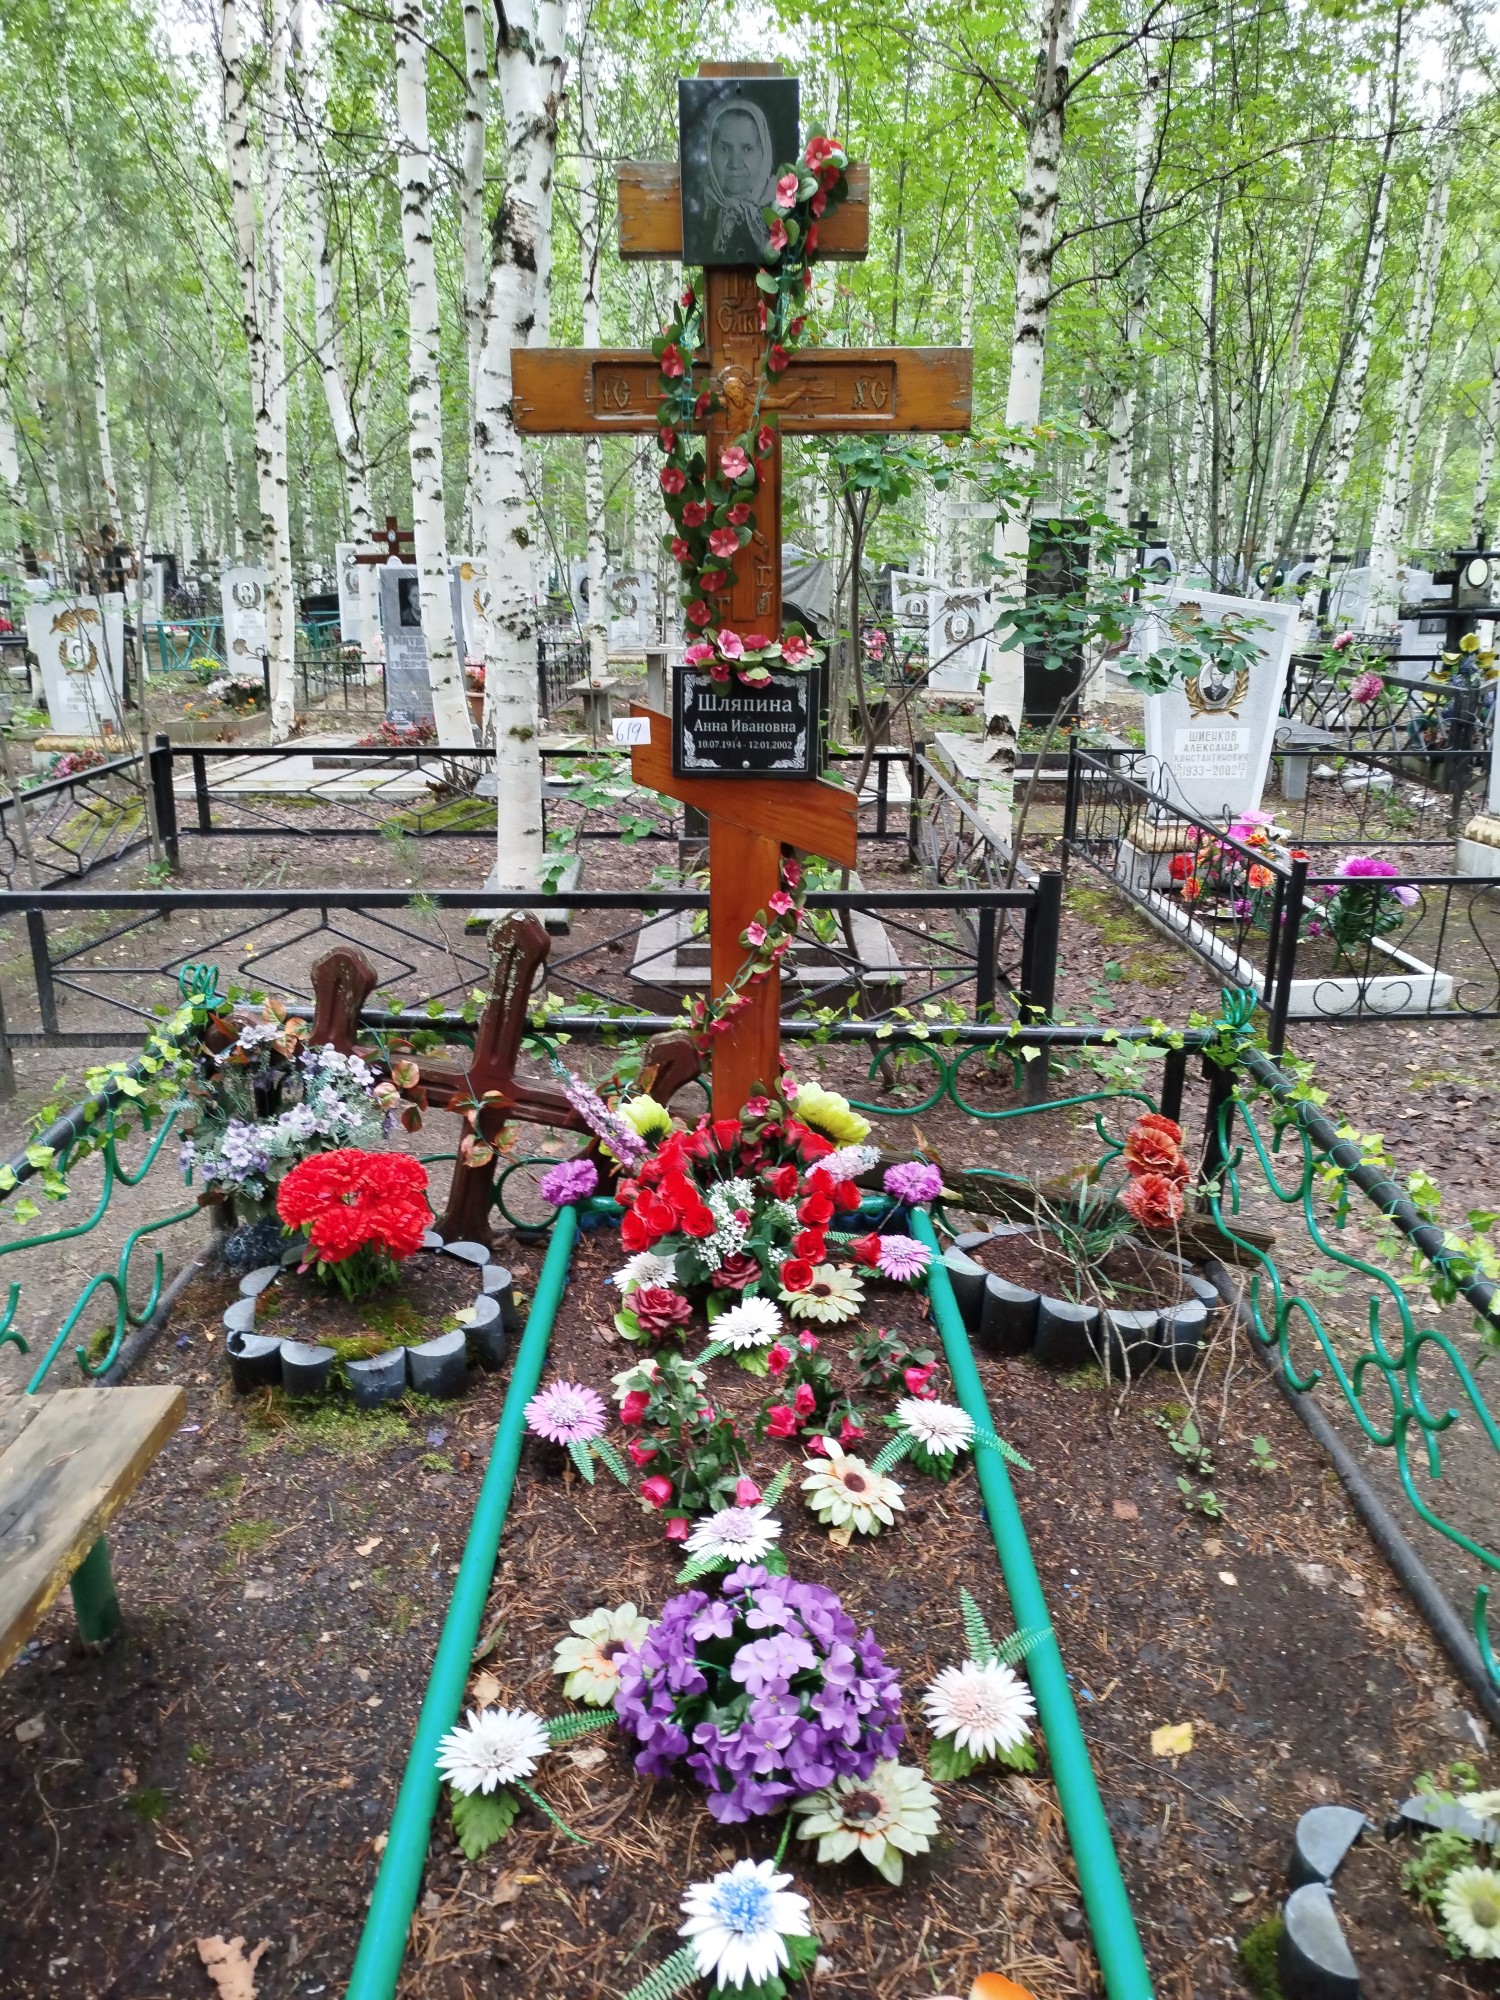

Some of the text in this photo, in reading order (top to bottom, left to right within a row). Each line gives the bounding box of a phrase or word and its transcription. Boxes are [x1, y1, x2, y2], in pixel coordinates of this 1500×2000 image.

[697, 693, 793, 713] Шляпина
[693, 718, 796, 733] Анна Ивановна
[616, 721, 642, 743] 619
[697, 740, 742, 749] 10.07.1914
[749, 740, 793, 750] 12.01.2002
[1183, 743, 1240, 753] АЛЕКСАНДР
[1173, 753, 1248, 763] КОНСТАНТИНОВИЧ
